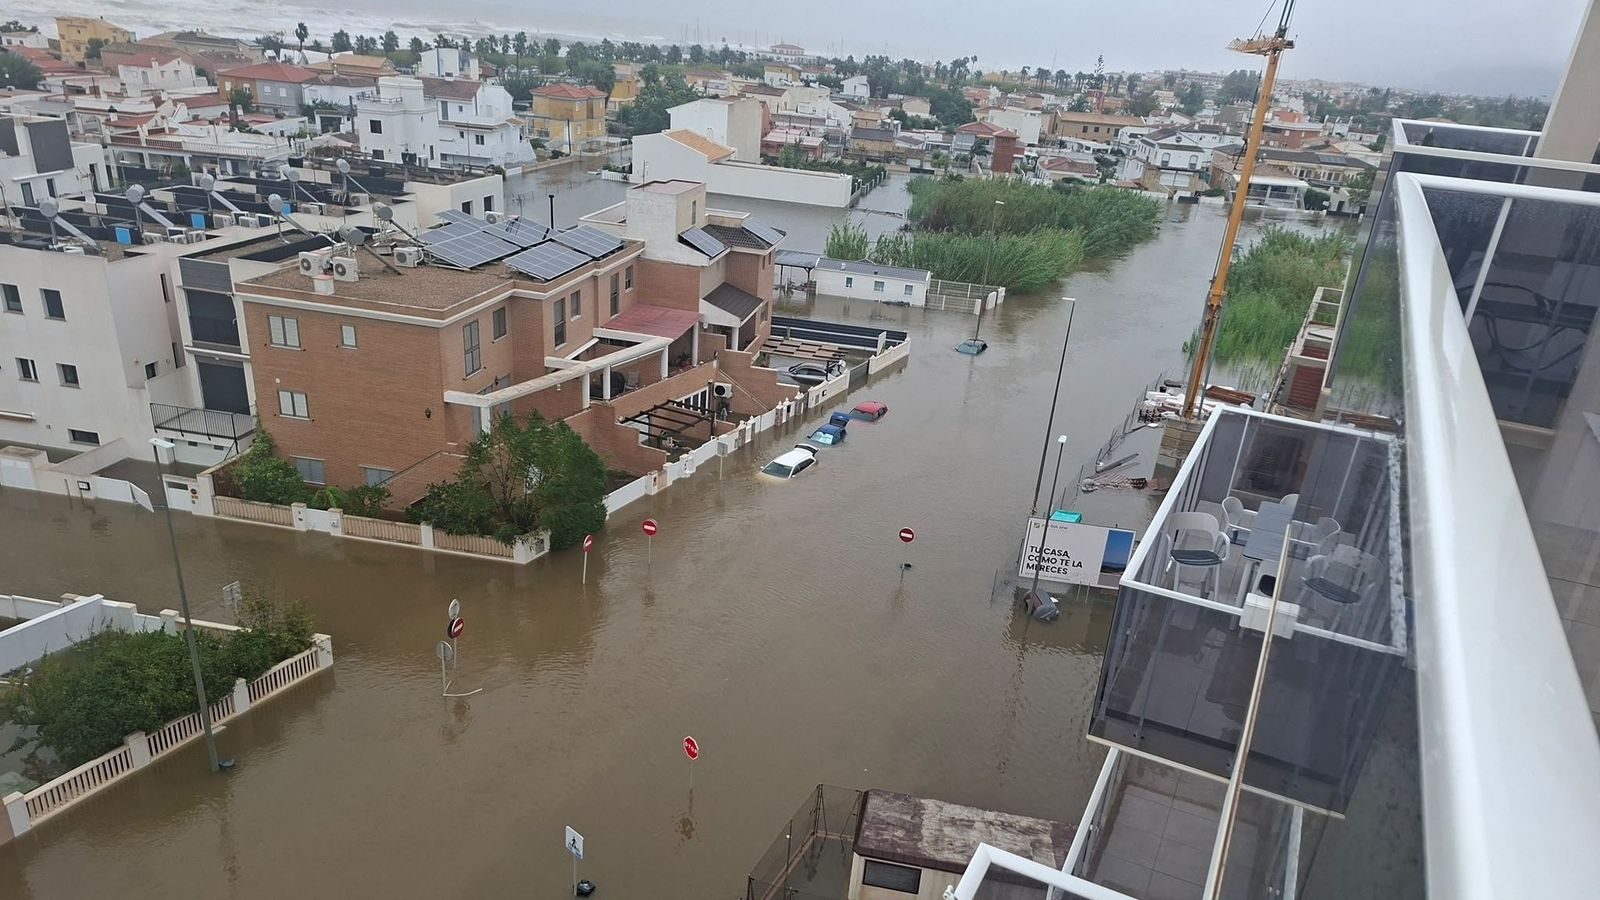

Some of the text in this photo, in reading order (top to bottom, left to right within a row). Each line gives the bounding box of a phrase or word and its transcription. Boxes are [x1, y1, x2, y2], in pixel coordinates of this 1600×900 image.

[1044, 548, 1070, 559] CASA,
[1028, 555, 1082, 568] COMO TE LA
[685, 741, 697, 754] STOP
